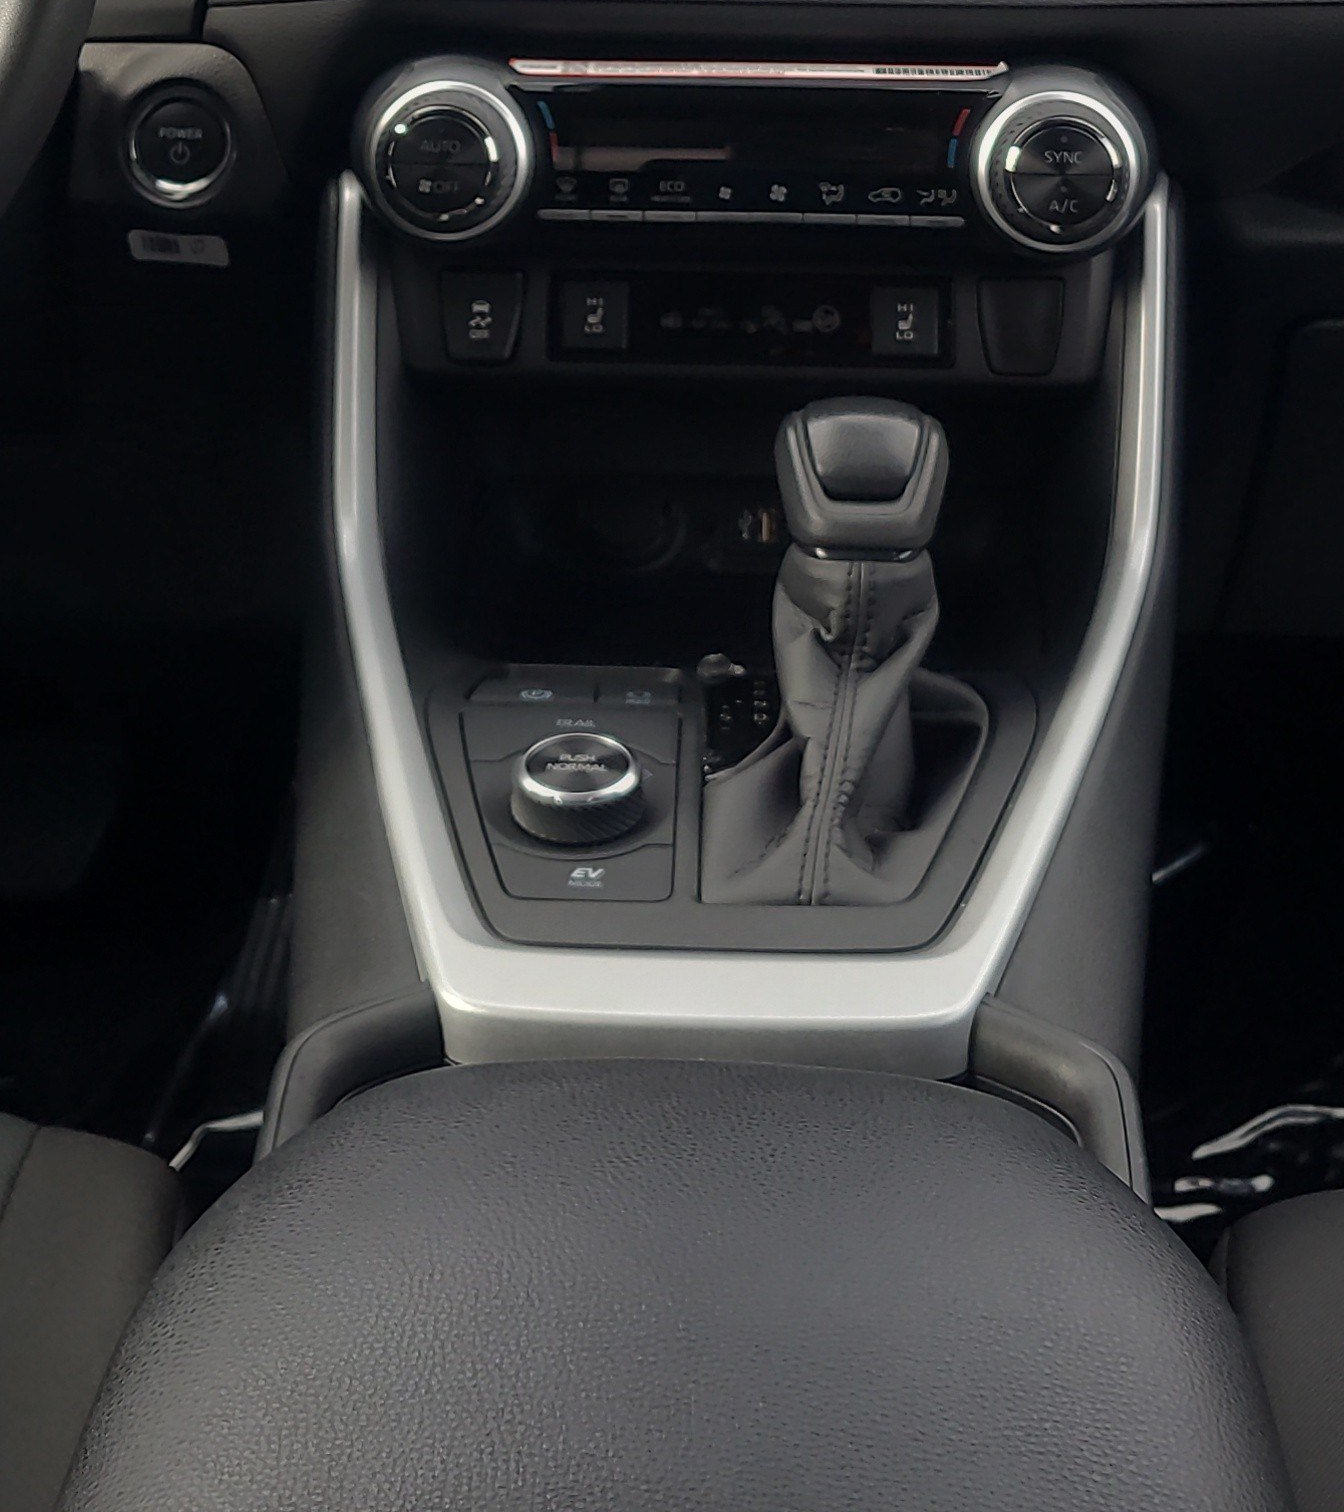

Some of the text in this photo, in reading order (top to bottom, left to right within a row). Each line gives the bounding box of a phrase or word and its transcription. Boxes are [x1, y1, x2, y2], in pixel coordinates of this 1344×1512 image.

[159, 126, 204, 139] POWER
[420, 139, 462, 154] AUTO
[1044, 149, 1083, 164] SYNC
[659, 179, 687, 193] ECO
[1048, 198, 1078, 214] A/C
[896, 303, 914, 312] HI
[895, 330, 914, 340] LO
[545, 762, 607, 772] NORMAL
[570, 867, 605, 878] EV
